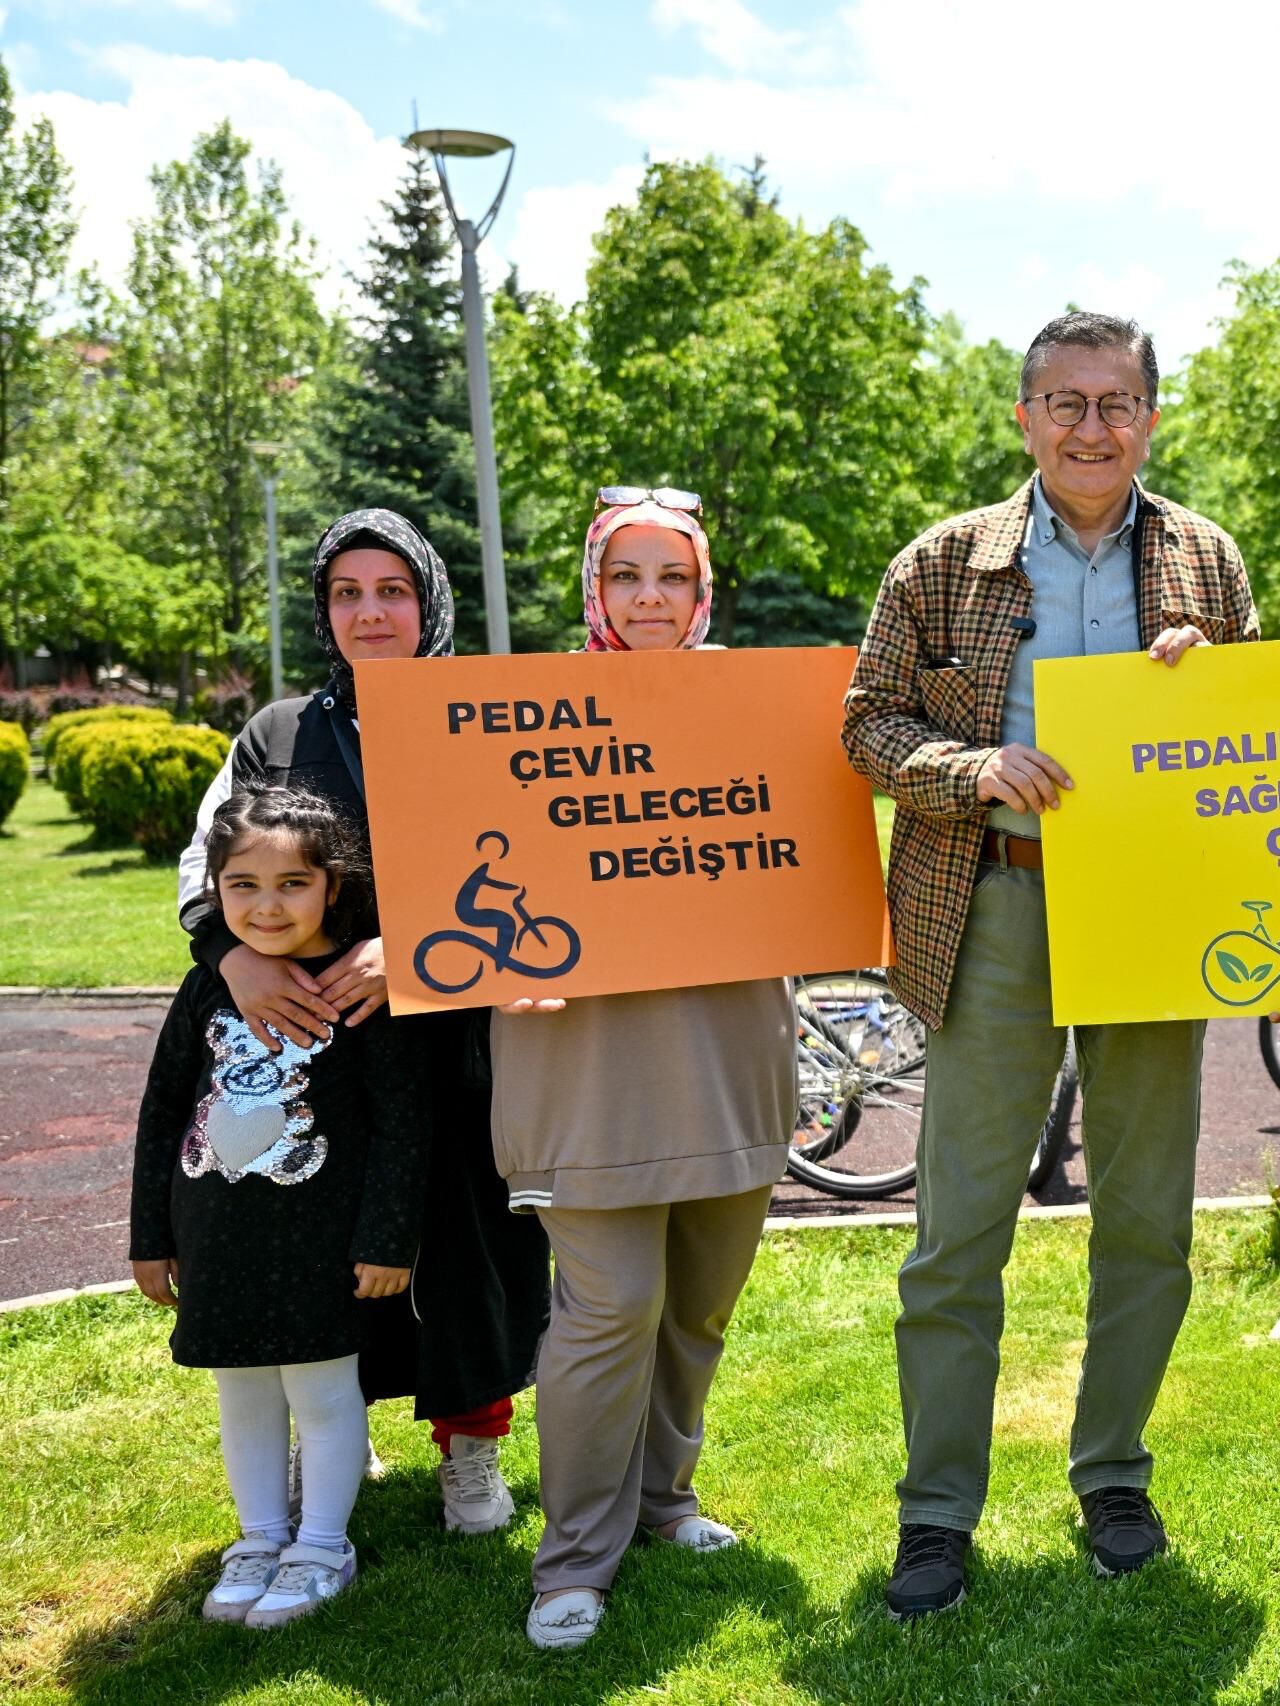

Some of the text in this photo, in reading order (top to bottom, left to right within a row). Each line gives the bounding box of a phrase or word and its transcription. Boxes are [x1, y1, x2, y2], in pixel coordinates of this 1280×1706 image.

[447, 696, 613, 735] PEDAL
[509, 736, 656, 789] ÇEVİR
[548, 774, 772, 828] GELECEĞİ
[589, 832, 801, 882] DEĞİŞTİR
